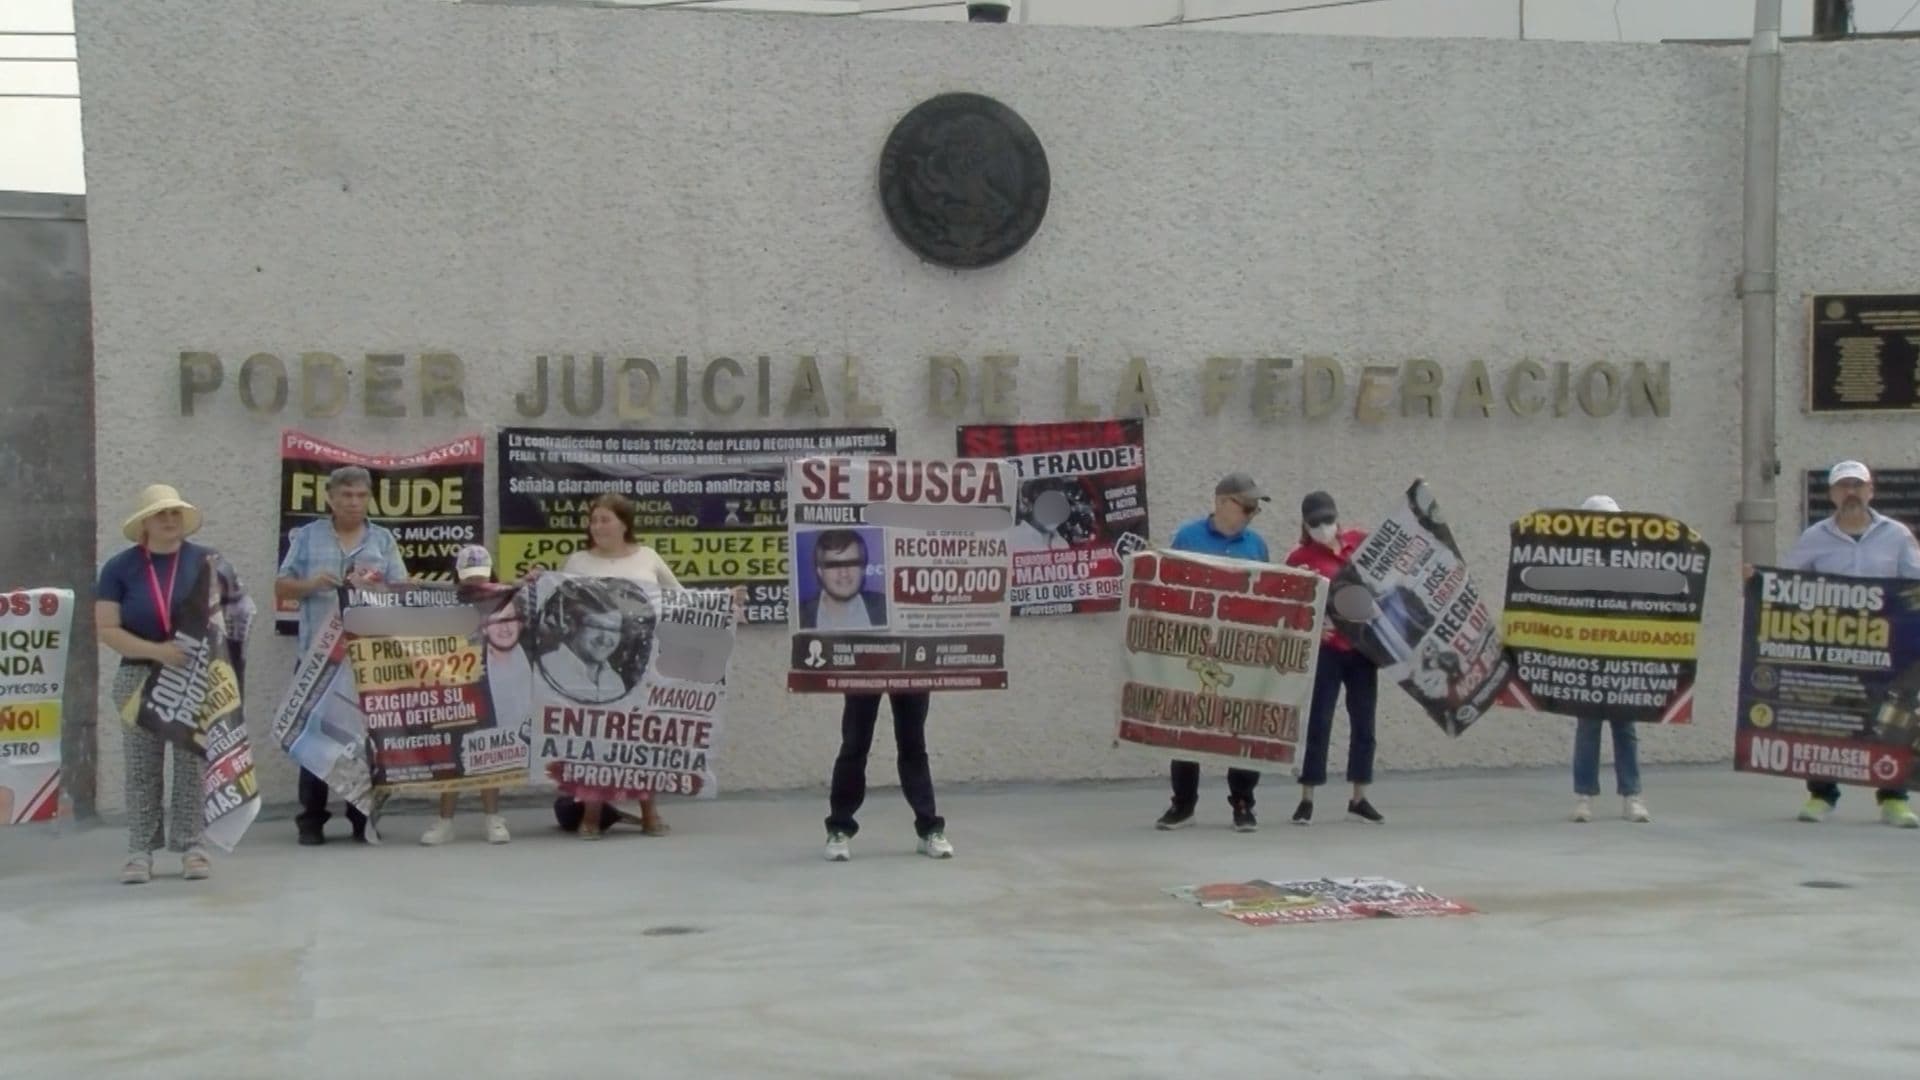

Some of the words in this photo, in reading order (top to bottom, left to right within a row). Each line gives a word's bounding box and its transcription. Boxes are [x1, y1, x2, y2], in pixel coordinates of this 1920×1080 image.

[179, 351, 466, 418] PODER
[515, 355, 882, 419] JUDICIAL
[928, 355, 1020, 419] DE
[1064, 355, 1158, 419] LA
[1203, 356, 1673, 422] FEDERACION
[726, 440, 761, 451] PLENO
[763, 438, 816, 450] REGIONAL
[1033, 447, 1136, 476] FRAUDE!
[509, 476, 554, 493] Señala
[557, 477, 633, 494] claramente
[635, 480, 660, 495] que
[663, 479, 703, 494] deben
[705, 477, 771, 493] analizarse
[801, 458, 851, 501] SE
[867, 459, 1005, 504] BUSCA
[554, 500, 575, 512] LA
[803, 506, 857, 523] MANUEL
[405, 525, 474, 541] MUCHOS
[633, 515, 698, 527] ERECHO
[1517, 513, 1681, 541] PROYECTOS
[417, 543, 438, 558] LA
[655, 538, 684, 555] EL
[687, 537, 753, 555] JUEZ
[894, 538, 1008, 558] RECOMPENSA
[1356, 518, 1401, 571] MANUEL
[708, 558, 740, 577] LO
[1512, 544, 1606, 568] MANUEL
[1610, 550, 1706, 574] ENRIQUE
[899, 569, 1001, 595] 1,000,000
[1035, 586, 1049, 600] LO
[1053, 584, 1073, 599] QUE
[1079, 583, 1094, 596] SE
[1761, 572, 1884, 611] Exigimos
[38, 592, 59, 617] 9
[347, 589, 403, 607] MANUEL
[405, 589, 459, 606] ENRIQUE
[660, 588, 734, 614] MANUEL
[1597, 599, 1628, 611] LEGAL
[1435, 582, 1480, 644] REGRE
[1758, 602, 1890, 648] justicia
[1128, 616, 1213, 655] QUEREMOS
[1214, 628, 1275, 667] JUECES
[1276, 637, 1312, 674] QUE
[1506, 620, 1575, 640] ¡FUIMOS
[1578, 624, 1696, 647] DEFRAUDADOS!
[348, 645, 367, 664] EL
[371, 635, 458, 662] PROTEGIDO
[1759, 642, 1812, 661] PRONTA
[1813, 646, 1825, 660] Y
[1826, 647, 1892, 668] EXPEDITA
[1517, 666, 1550, 683] QUE
[1552, 669, 1588, 686] NOS
[1591, 674, 1678, 693] DEVUELVAN
[1668, 663, 1681, 676] Y
[365, 689, 440, 713] EXIGIMOS
[443, 687, 464, 704] SU
[1531, 682, 1604, 703] NUESTRO
[405, 701, 477, 725] DETENCIÓN
[1195, 697, 1216, 728] SU
[1220, 701, 1299, 740] PROTESTA
[468, 736, 487, 753] NO
[489, 728, 516, 748] MÁS
[543, 706, 713, 750] ENTRÉGATE
[383, 735, 441, 751] PROYECTOS
[469, 744, 528, 767] IMPUNIDAD
[541, 737, 559, 758] A
[566, 739, 595, 762] LA
[602, 742, 707, 772] JUSTICIA
[1751, 735, 1789, 772] NO
[1792, 743, 1871, 767] RETRASEN
[562, 762, 679, 792] #PROYECTOS
[680, 774, 694, 795] 9
[1791, 761, 1807, 774] LA
[1809, 762, 1871, 781] SENTENCIA
